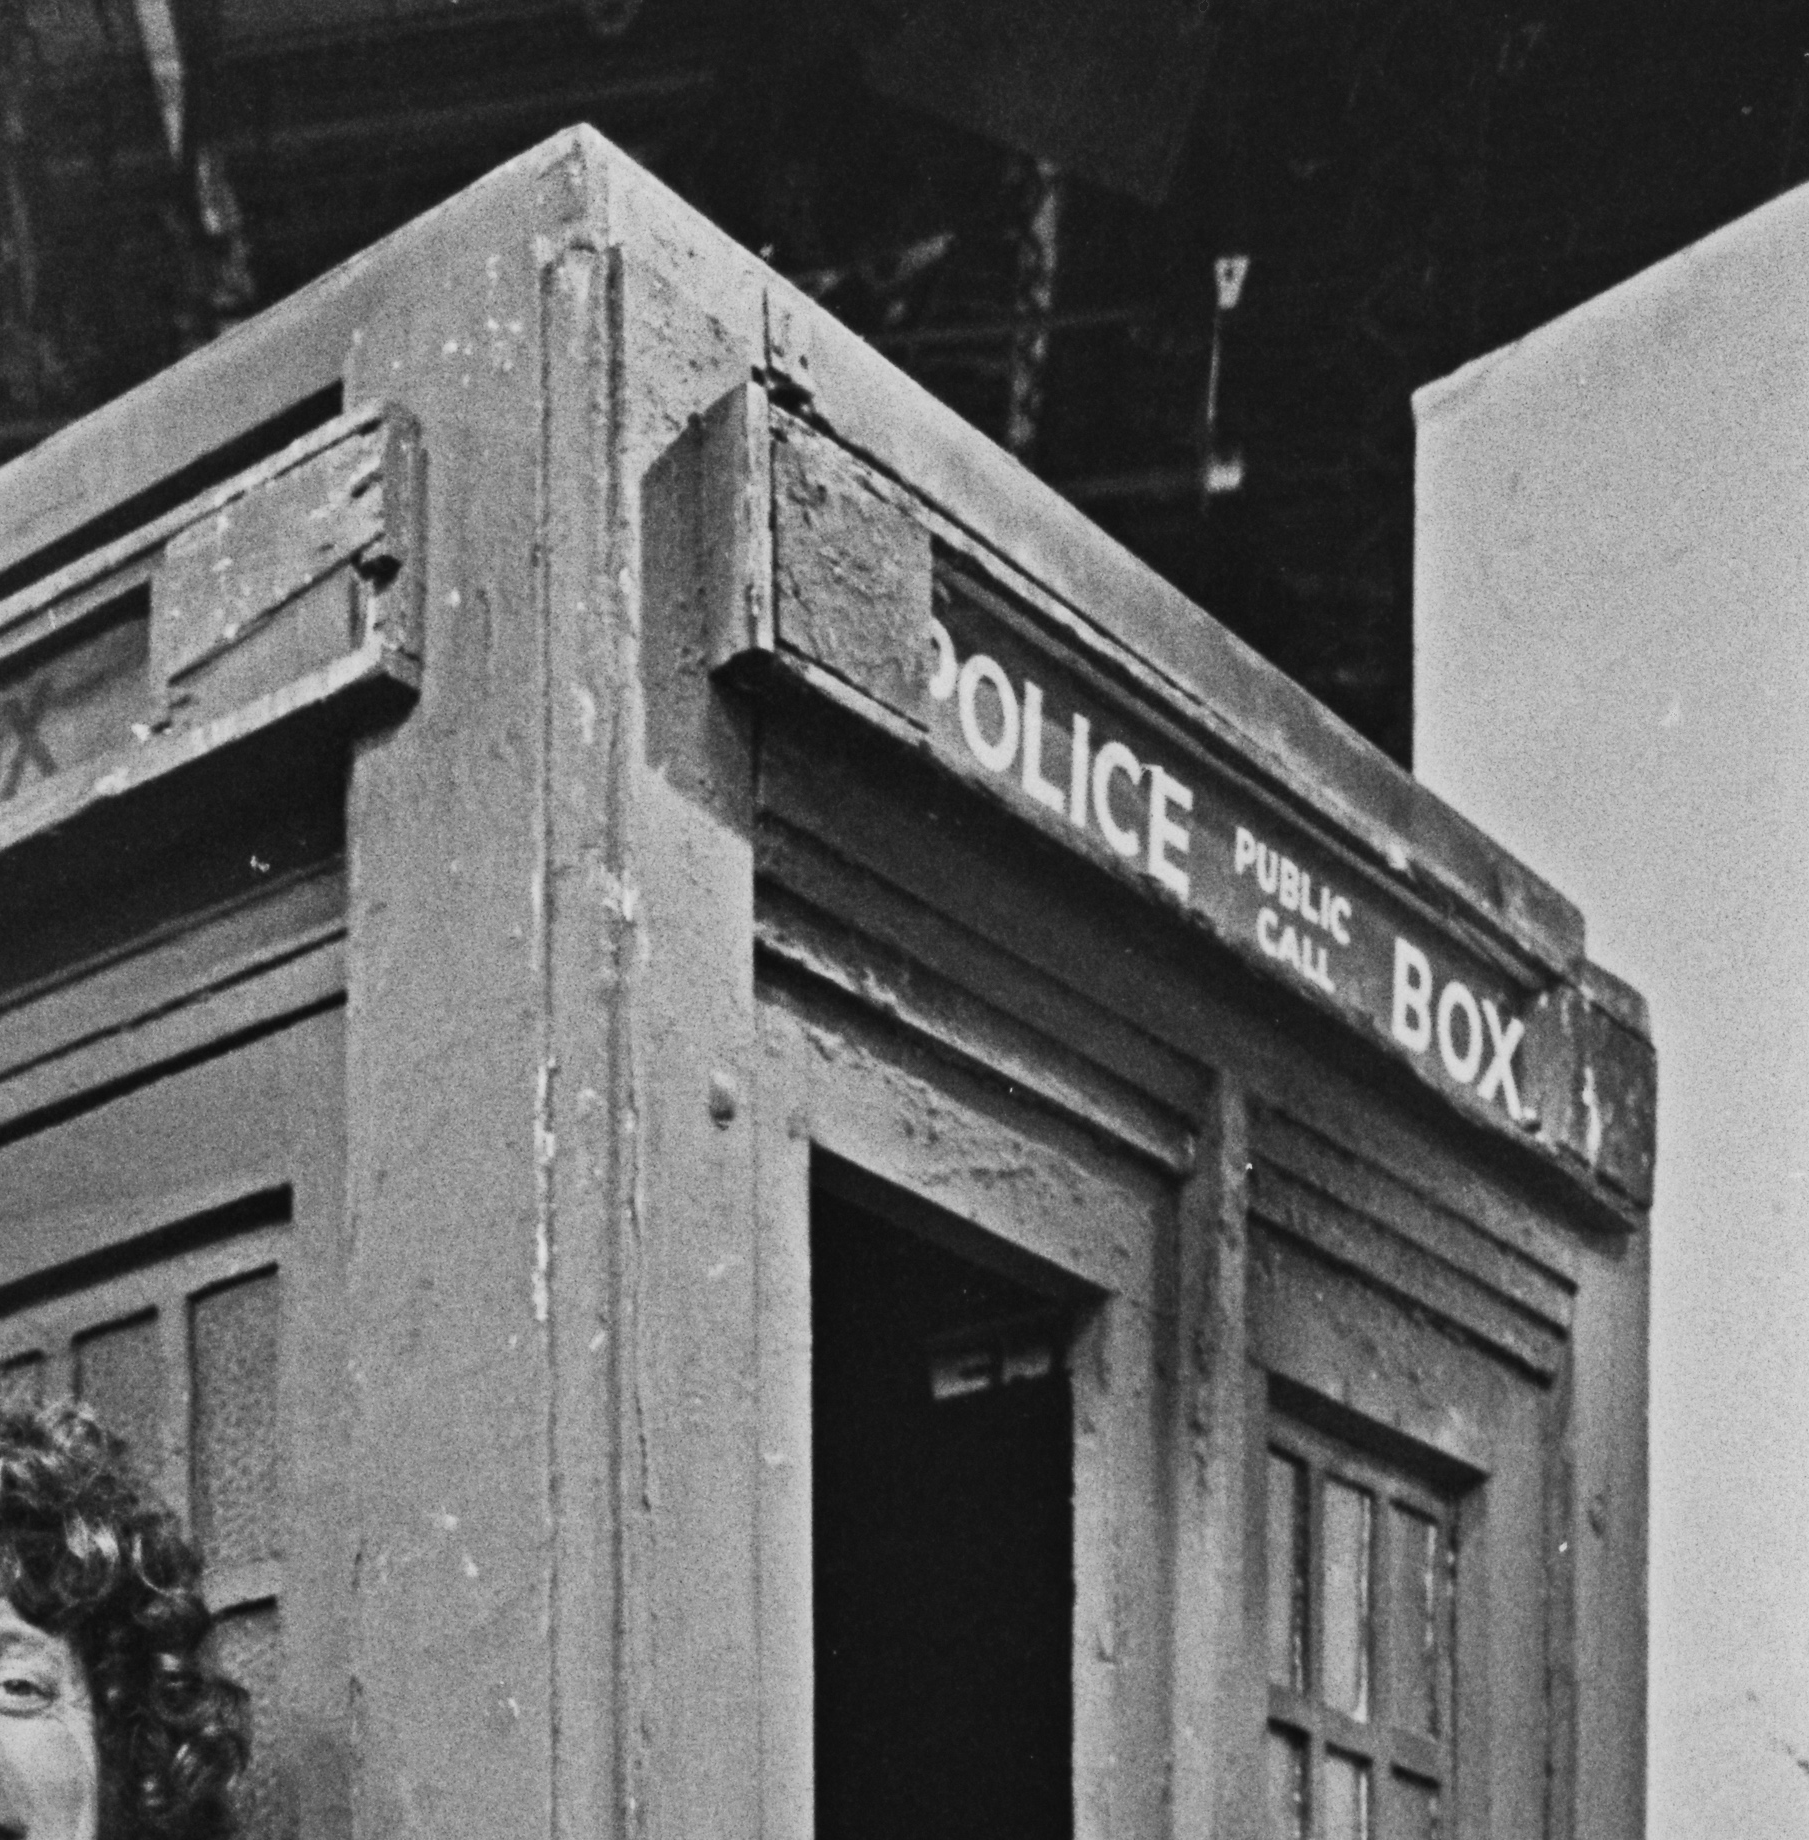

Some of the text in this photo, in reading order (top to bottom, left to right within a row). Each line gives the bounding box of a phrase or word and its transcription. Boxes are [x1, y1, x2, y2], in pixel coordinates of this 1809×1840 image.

[1235, 826, 1353, 947] PUBLIC
[1256, 906, 1337, 995] CALL
[1392, 935, 1526, 1121] BOX
